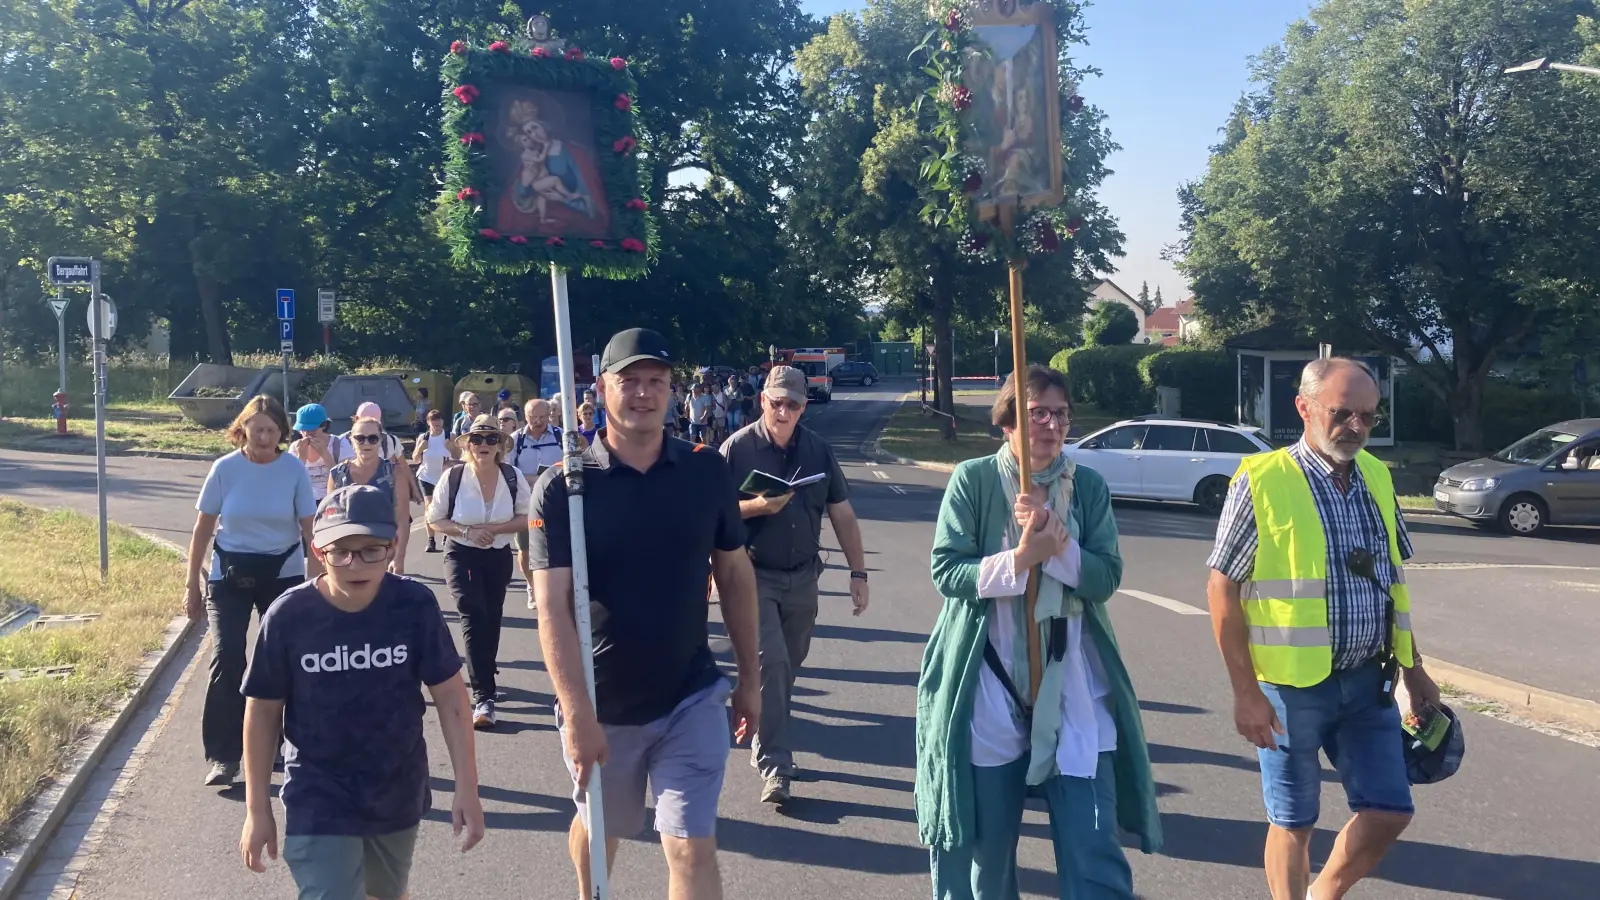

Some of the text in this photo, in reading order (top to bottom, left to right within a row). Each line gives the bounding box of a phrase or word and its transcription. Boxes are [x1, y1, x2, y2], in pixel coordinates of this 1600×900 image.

[56, 264, 88, 279] Bergauffahrt
[283, 322, 290, 338] P
[300, 643, 408, 673] adidas
